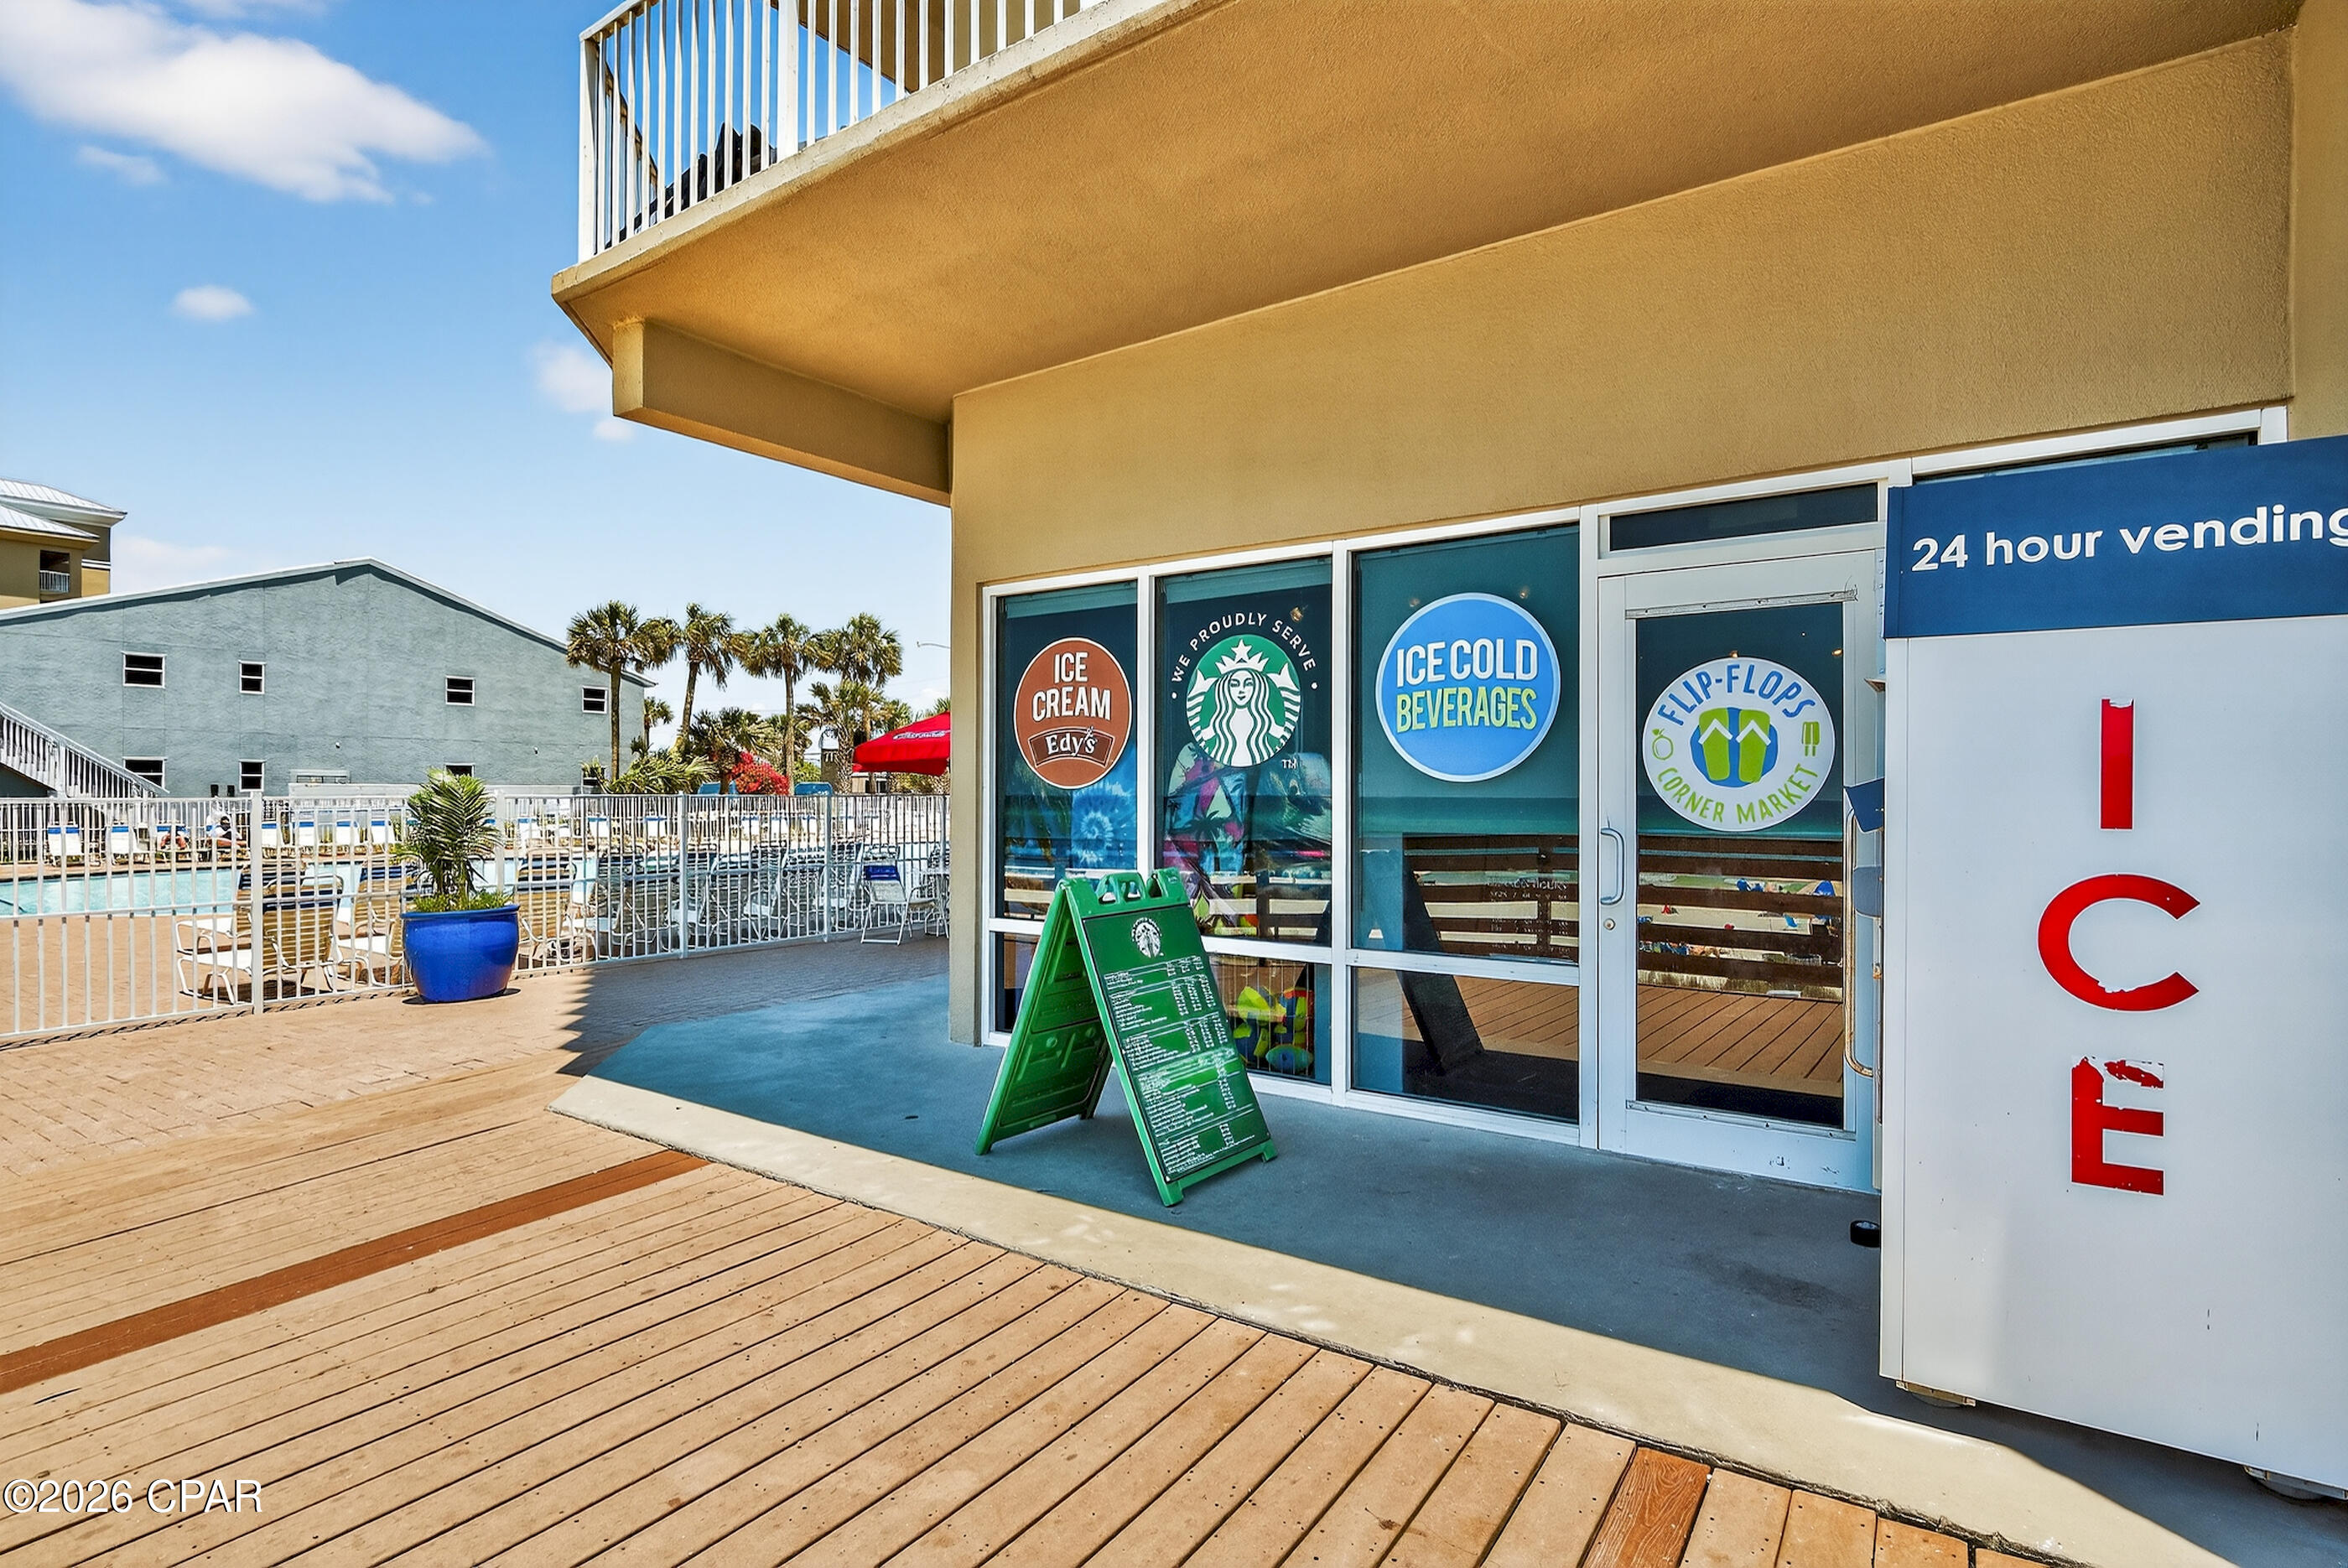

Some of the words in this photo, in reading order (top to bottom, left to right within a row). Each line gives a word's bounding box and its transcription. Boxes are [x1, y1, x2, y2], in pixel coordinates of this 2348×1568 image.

[1911, 534, 1969, 571] 24
[1986, 531, 2103, 566] hour
[1054, 652, 1089, 684] ICE
[1171, 654, 1191, 683] WE
[1189, 612, 1268, 651] PROUDLY
[1271, 620, 1317, 672] SERVE
[1395, 641, 1447, 688] ICE
[1449, 637, 1539, 681] COLD
[1032, 686, 1112, 723] CREAM
[1396, 686, 1538, 734] BEVERAGES
[1657, 663, 1816, 727] FLIP-FLOPS
[1046, 725, 1098, 757] Edy's
[1657, 766, 1725, 823] CORNER
[1735, 763, 1818, 824] MARKET
